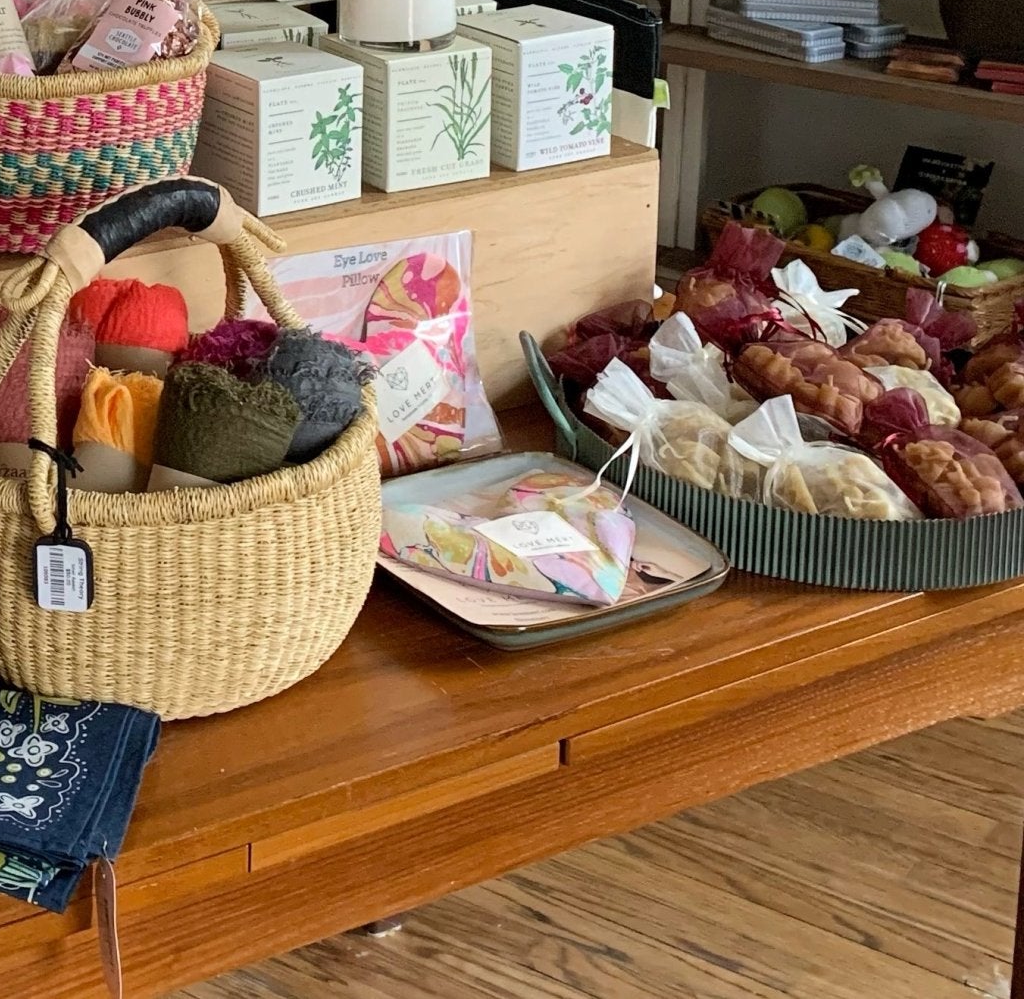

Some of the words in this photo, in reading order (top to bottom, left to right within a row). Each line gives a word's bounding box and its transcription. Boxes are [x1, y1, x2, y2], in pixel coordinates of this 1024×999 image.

[124, 6, 155, 23] BUBBLY
[109, 34, 138, 50] CHOCOLATE
[116, 30, 137, 41] SEATTLE
[539, 146, 558, 155] WILD
[560, 141, 588, 152] TOMATO
[588, 137, 605, 147] VINE
[411, 166, 438, 176] FRESH
[440, 162, 457, 171] CUT
[459, 159, 484, 168] GRASS
[290, 185, 327, 199] CRUSHED
[328, 180, 348, 192] MINT
[333, 255, 356, 269] Eye
[358, 250, 388, 265] Love
[342, 273, 380, 288] Pillow
[386, 399, 412, 424] LOVE
[414, 376, 436, 399] MERT
[512, 539, 540, 549] LOVE
[77, 577, 86, 600] Theory
